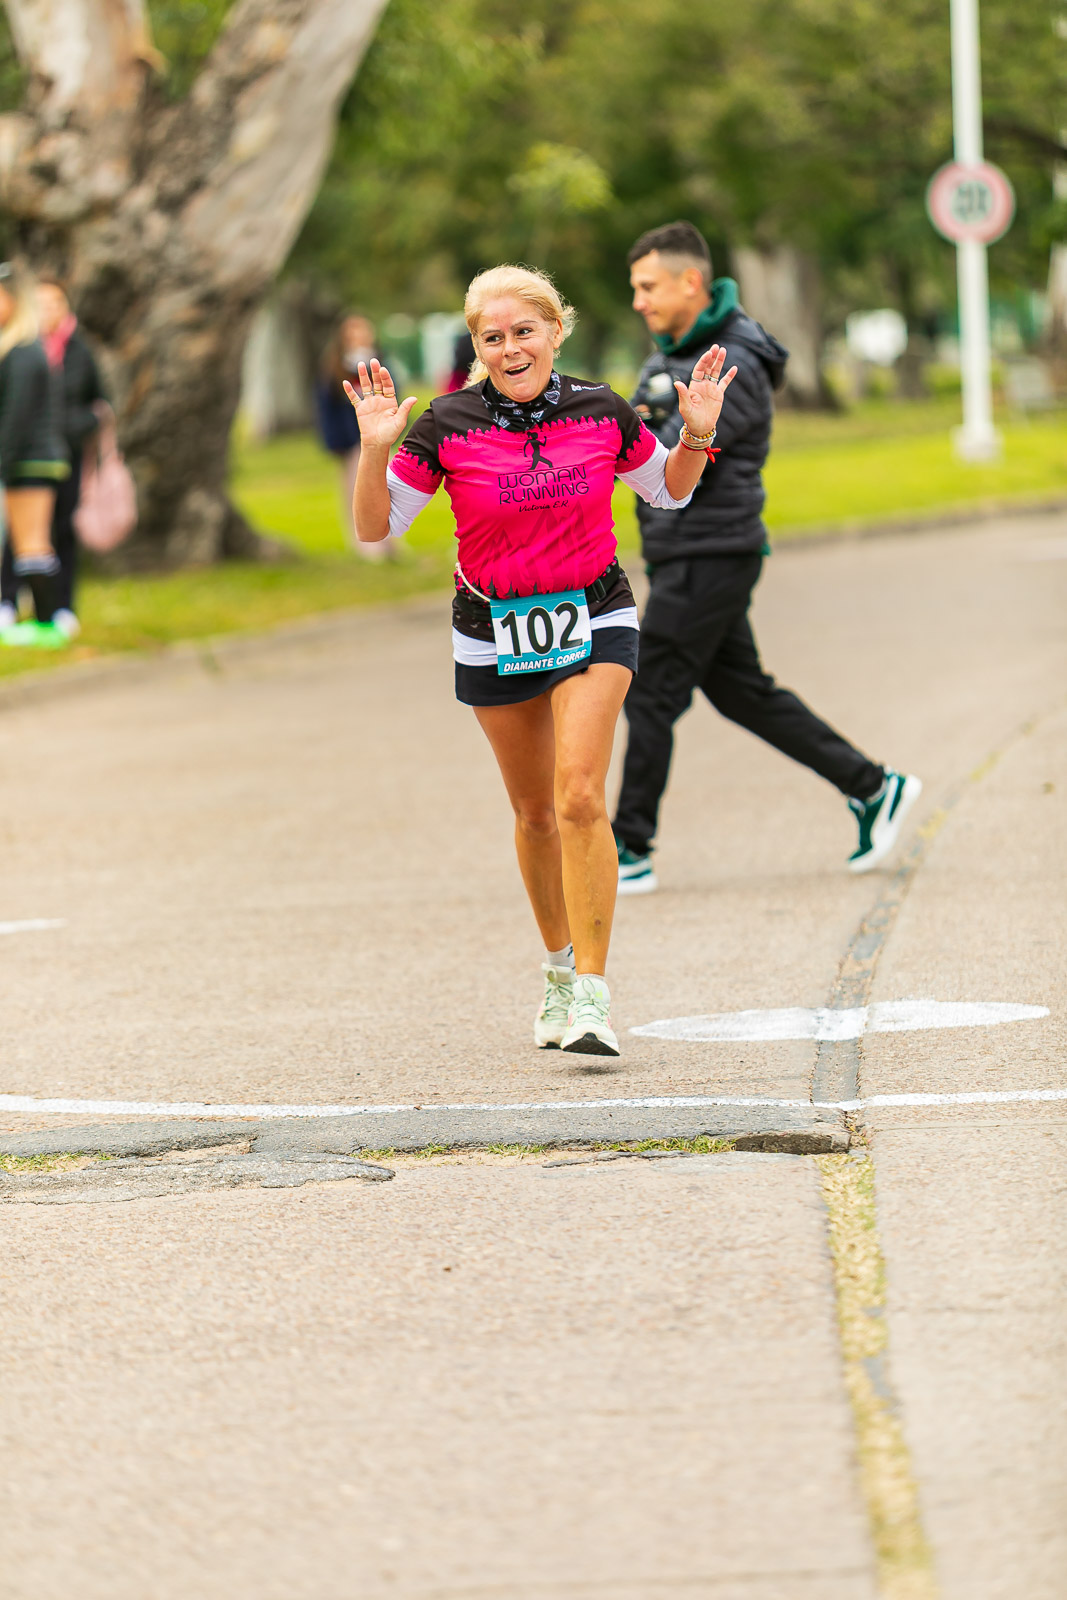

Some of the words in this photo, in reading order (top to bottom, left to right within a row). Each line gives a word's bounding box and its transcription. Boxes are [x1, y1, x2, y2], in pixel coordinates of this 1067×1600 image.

[498, 466, 587, 490] WOMAN
[499, 481, 590, 505] RUNNING
[518, 503, 551, 513] Victoria
[500, 601, 583, 658] 102
[503, 656, 555, 673] DIAMANTE
[555, 648, 588, 666] CORRE
